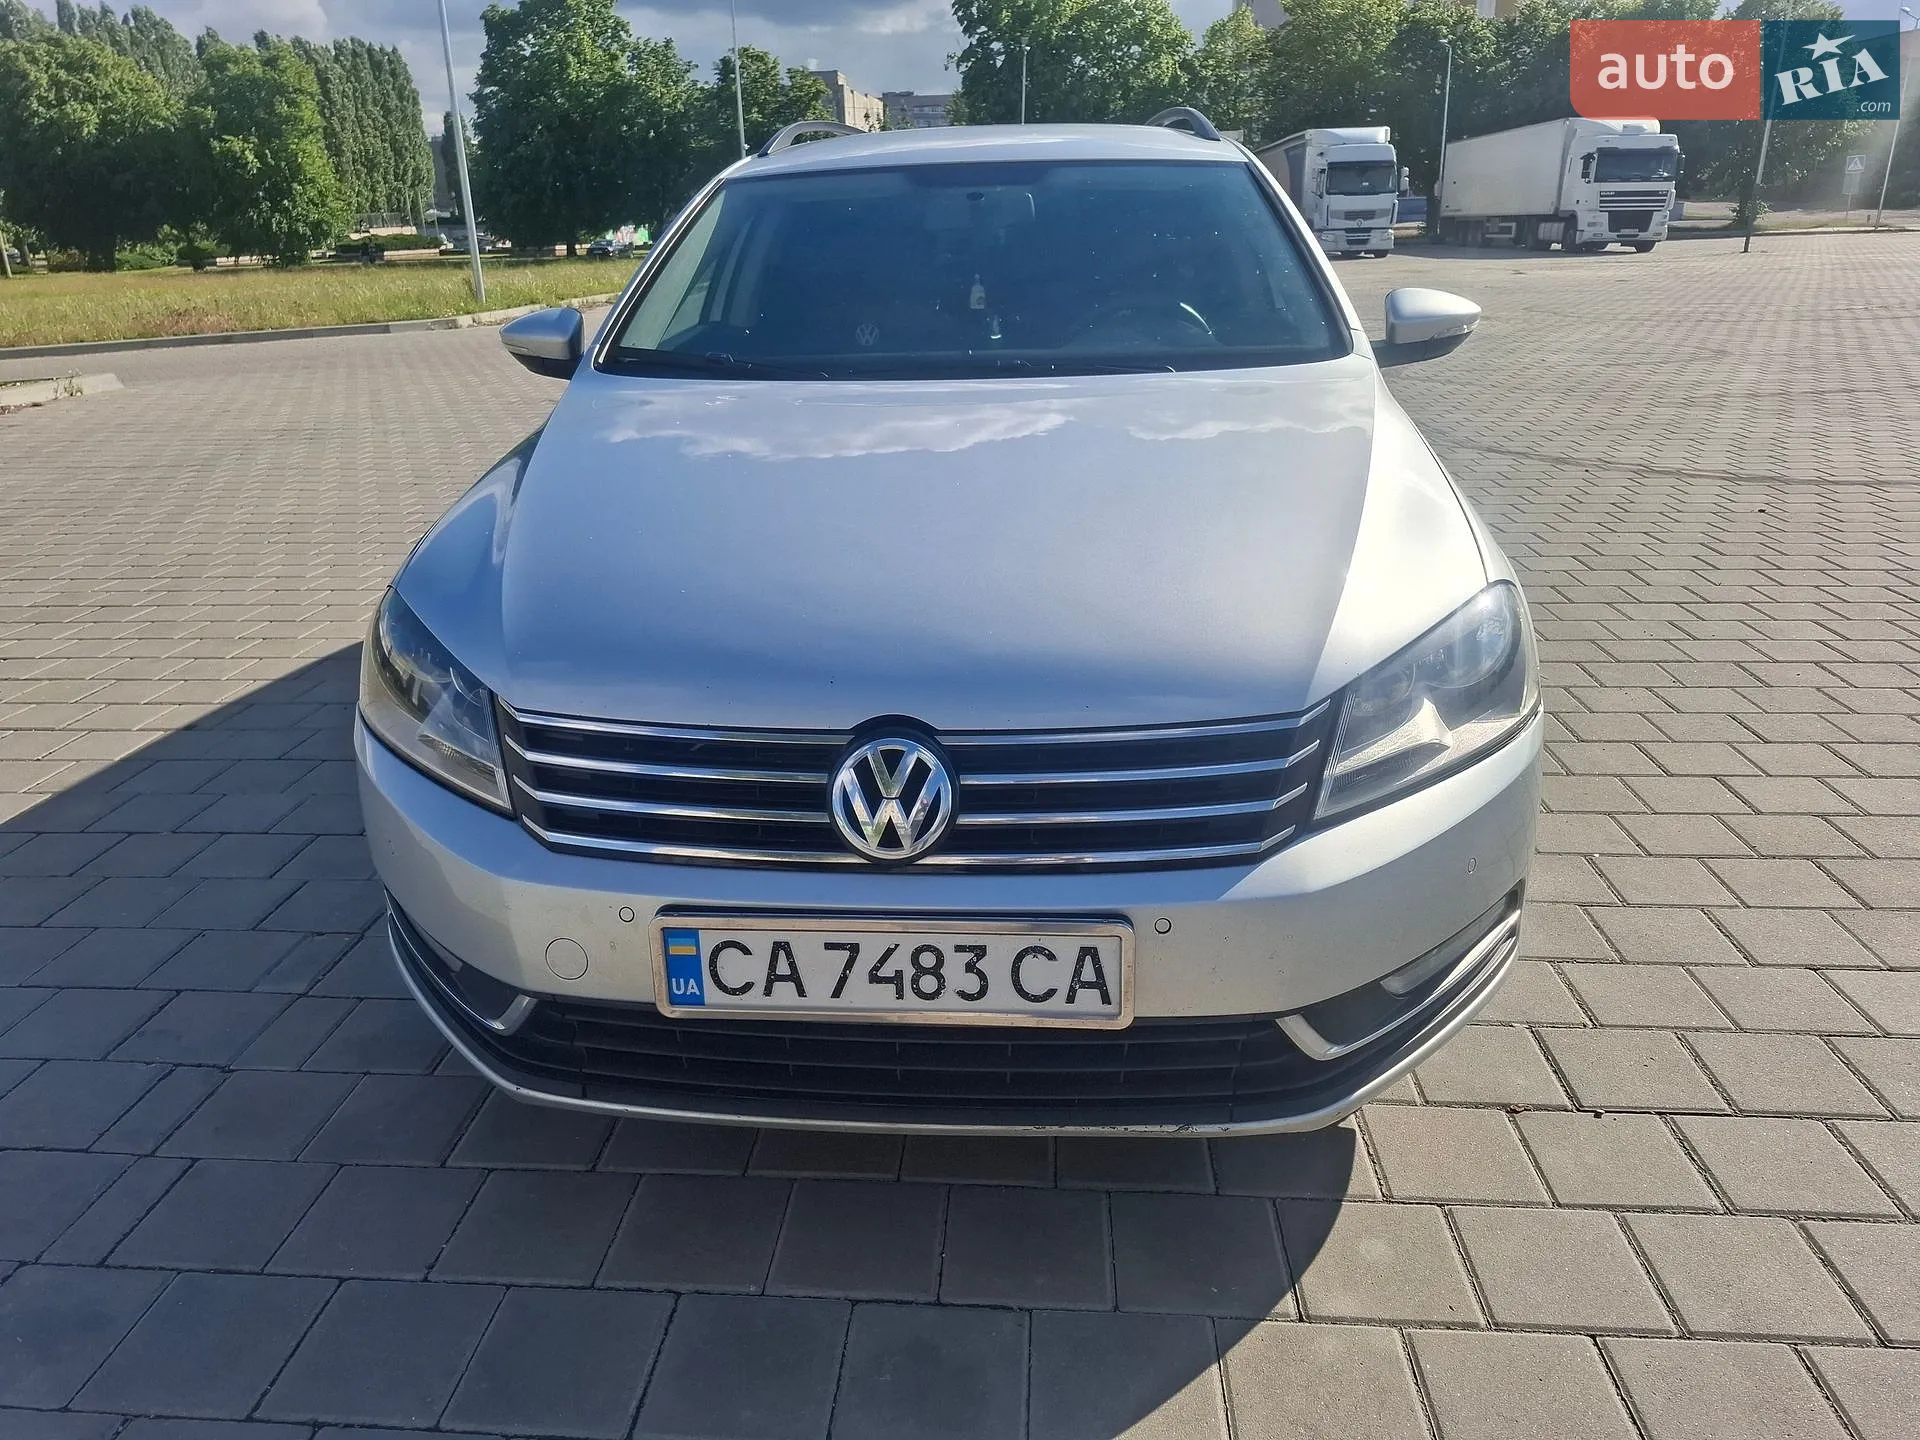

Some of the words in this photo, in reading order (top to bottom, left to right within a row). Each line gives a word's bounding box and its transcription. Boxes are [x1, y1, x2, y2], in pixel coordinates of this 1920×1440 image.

[671, 977, 701, 996] UA
[708, 939, 807, 997] CA
[823, 941, 989, 1001] 7483
[1010, 945, 1112, 1005] CA
